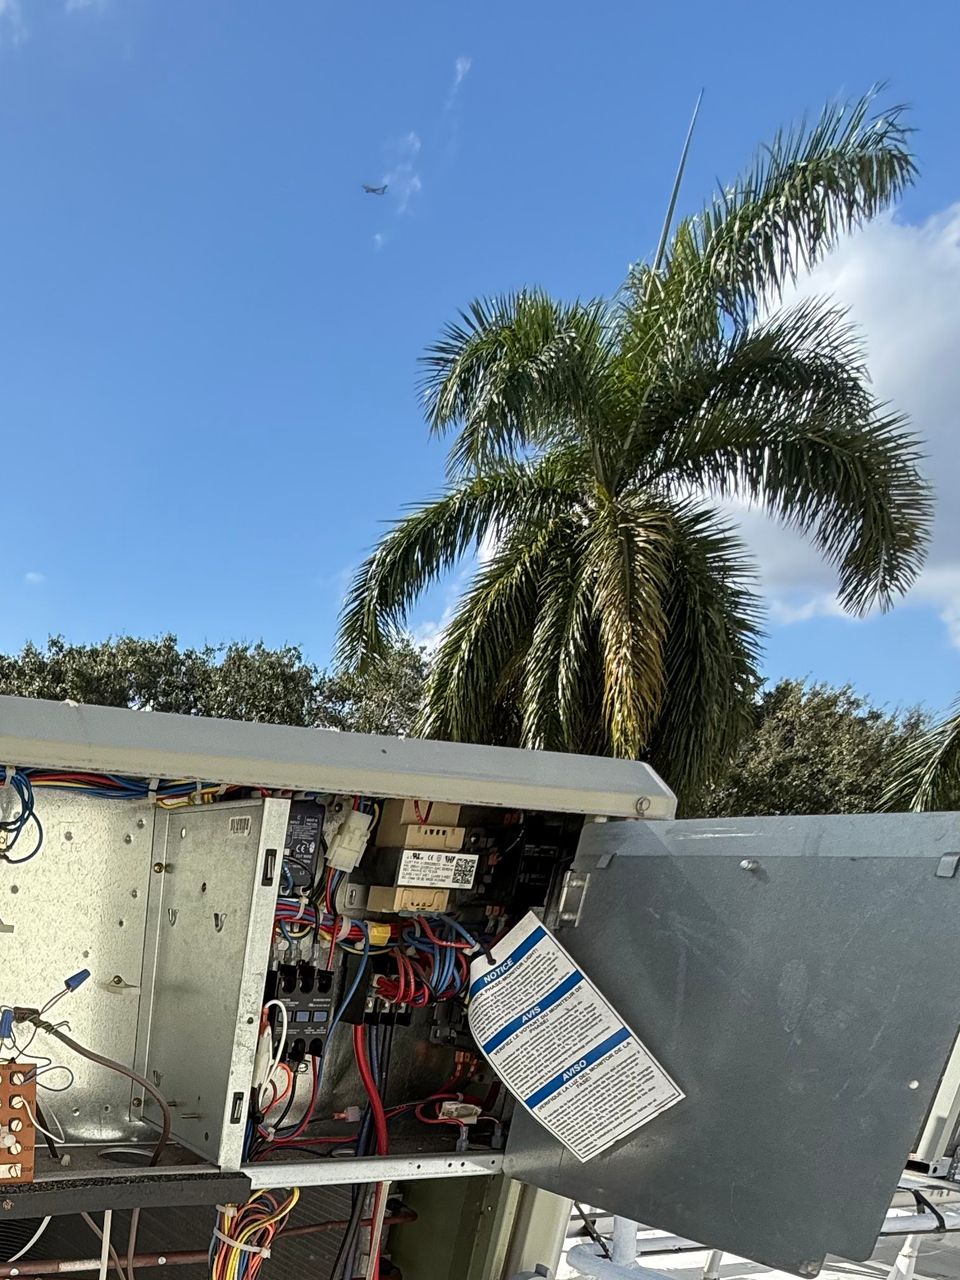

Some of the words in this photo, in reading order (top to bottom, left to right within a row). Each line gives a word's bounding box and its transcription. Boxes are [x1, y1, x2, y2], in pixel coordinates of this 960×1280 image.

[483, 958, 515, 984] NOTICE
[521, 1005, 541, 1024] AVIS
[562, 1059, 587, 1082] AVISO
